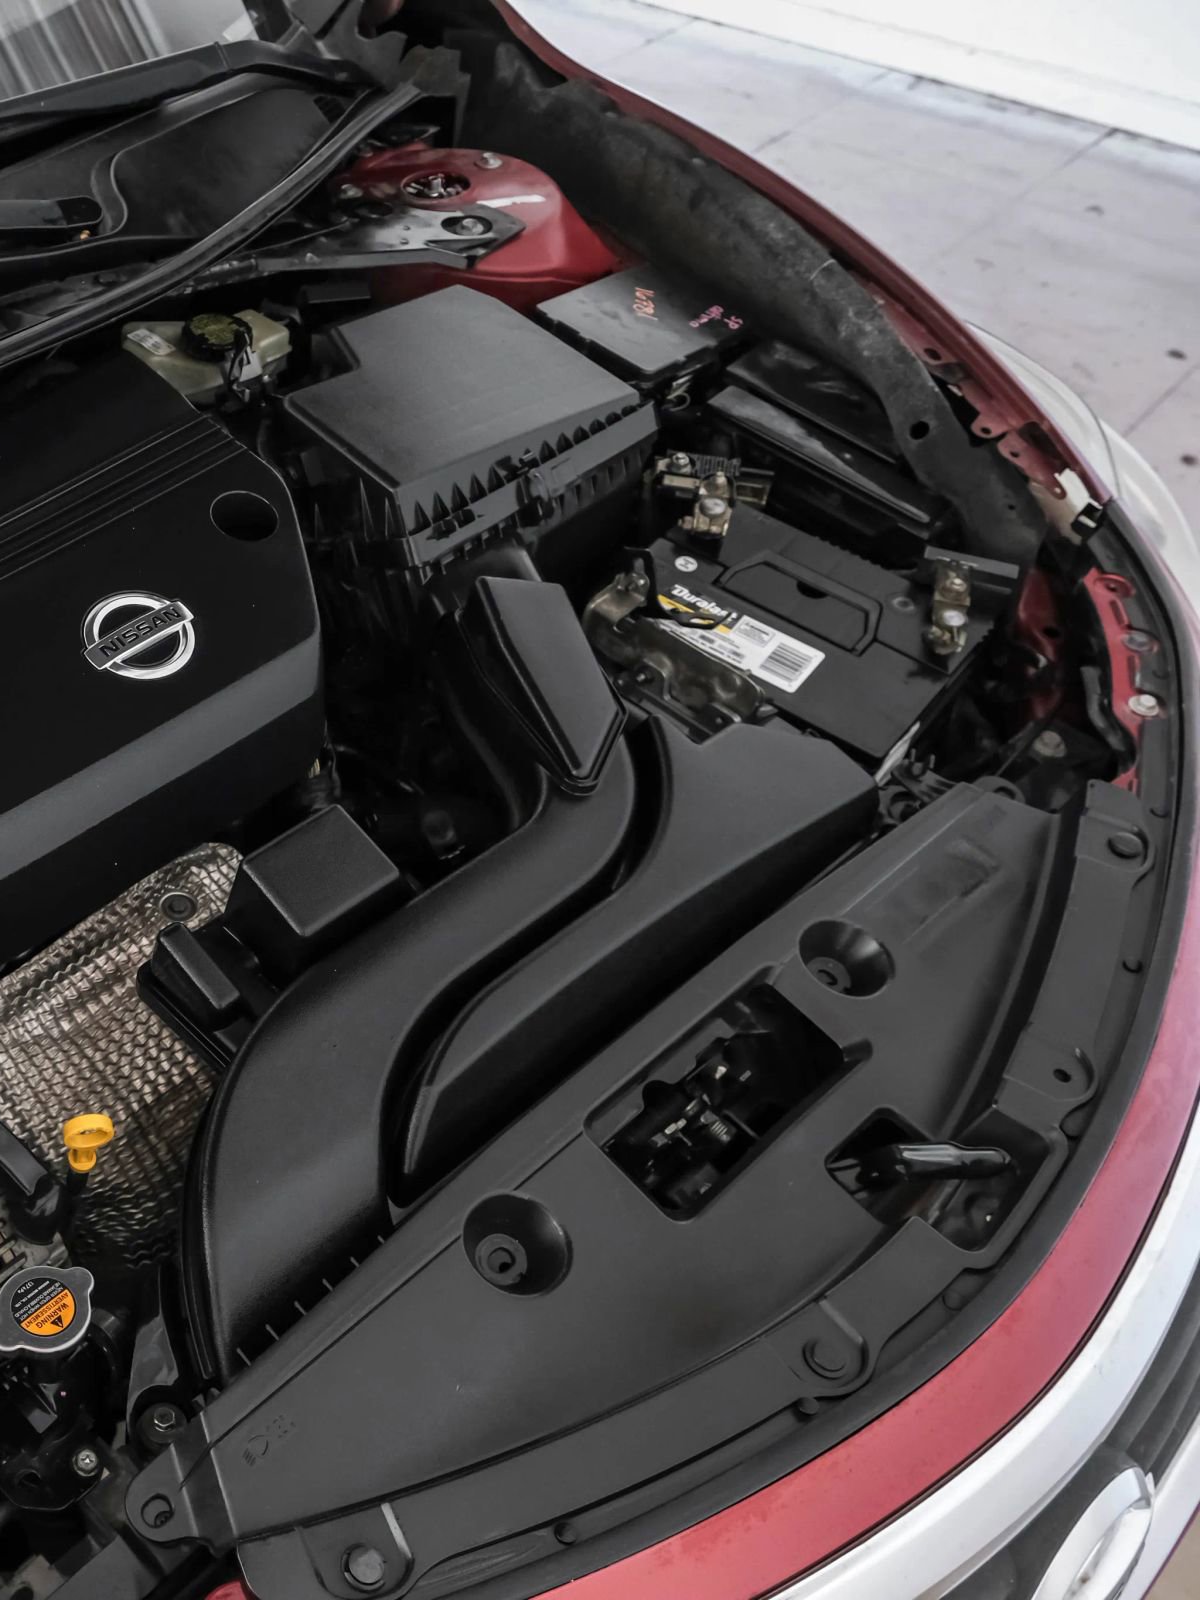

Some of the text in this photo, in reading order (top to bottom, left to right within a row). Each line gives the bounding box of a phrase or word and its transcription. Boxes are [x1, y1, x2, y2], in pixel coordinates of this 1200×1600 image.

[98, 606, 182, 658] NISSAN
[24, 1292, 68, 1328] AVERTISSEMENT
[36, 1303, 68, 1328] WARNING
